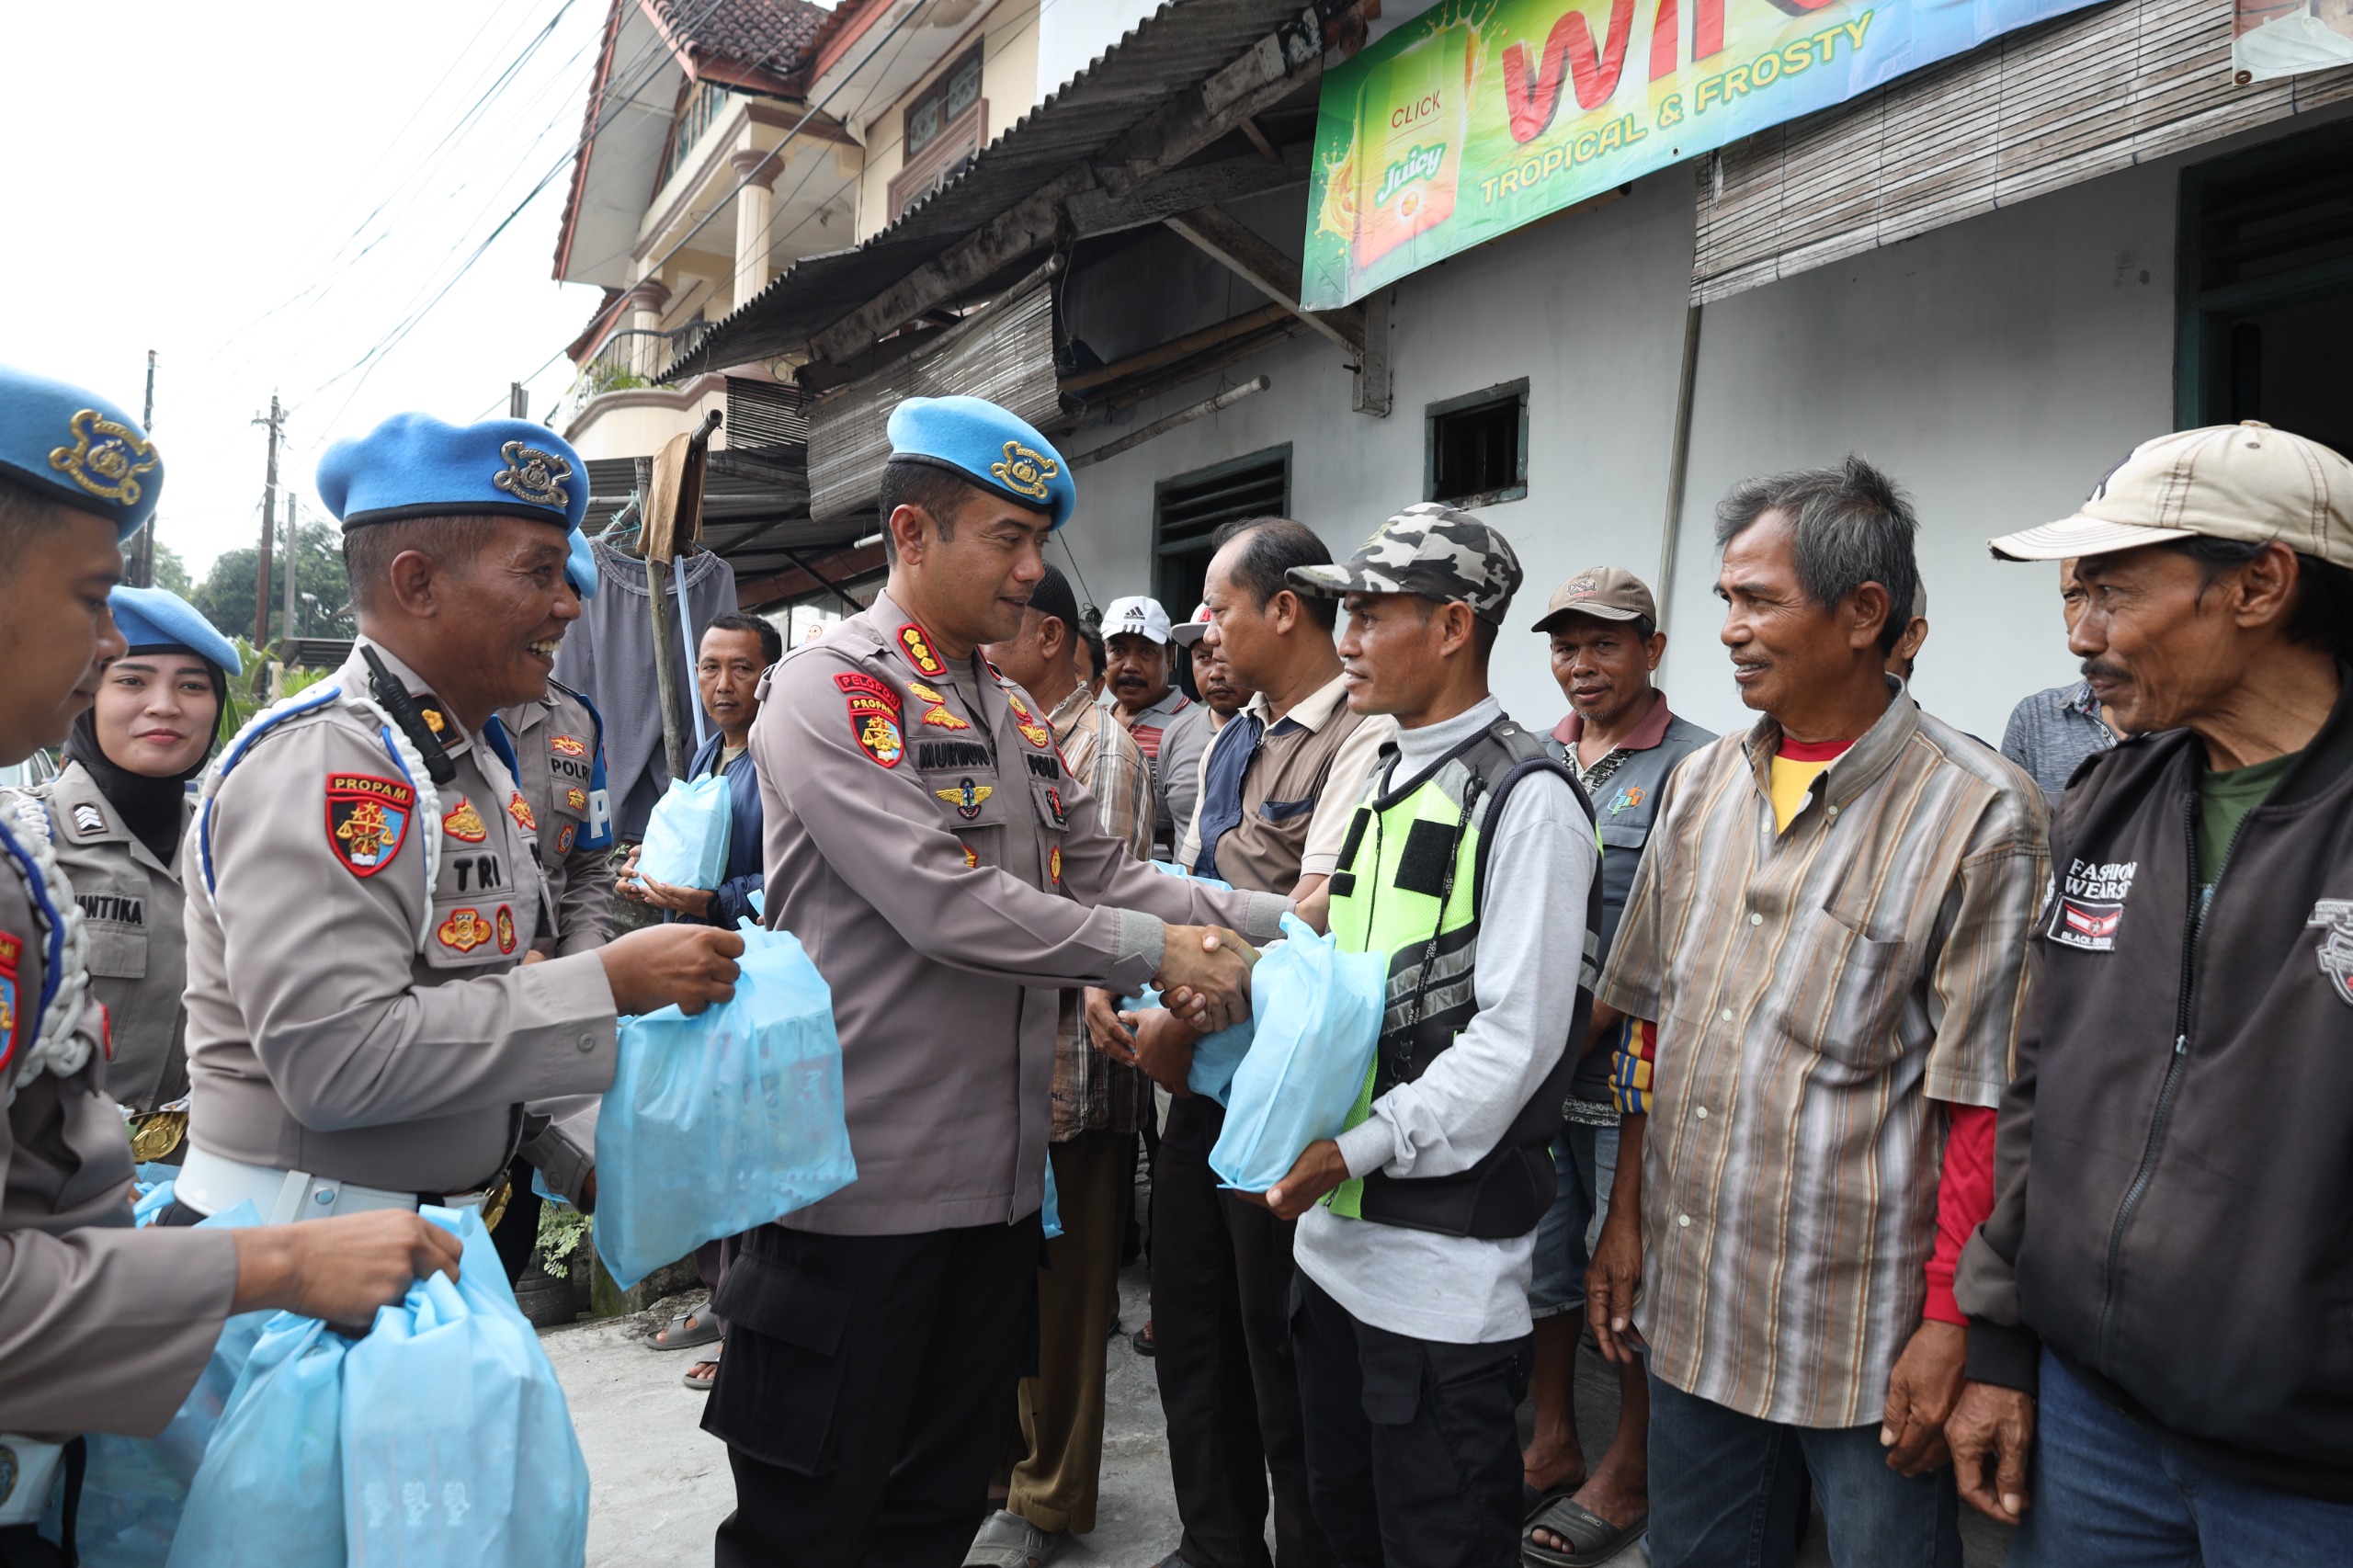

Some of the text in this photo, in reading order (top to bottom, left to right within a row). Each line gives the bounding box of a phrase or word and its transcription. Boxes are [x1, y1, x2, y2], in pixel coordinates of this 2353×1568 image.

[1392, 90, 1440, 129] CLICK
[1481, 13, 1874, 203] TROPICAL & FROSTY
[1376, 147, 1443, 204] Juicy
[852, 699, 895, 717] PROPAM
[551, 757, 590, 784] POLRI
[335, 778, 407, 801] PROPAM
[588, 789, 612, 839] P
[453, 855, 501, 892] TRI
[2069, 858, 2138, 882] FASHION
[74, 894, 142, 926] ANTIKA
